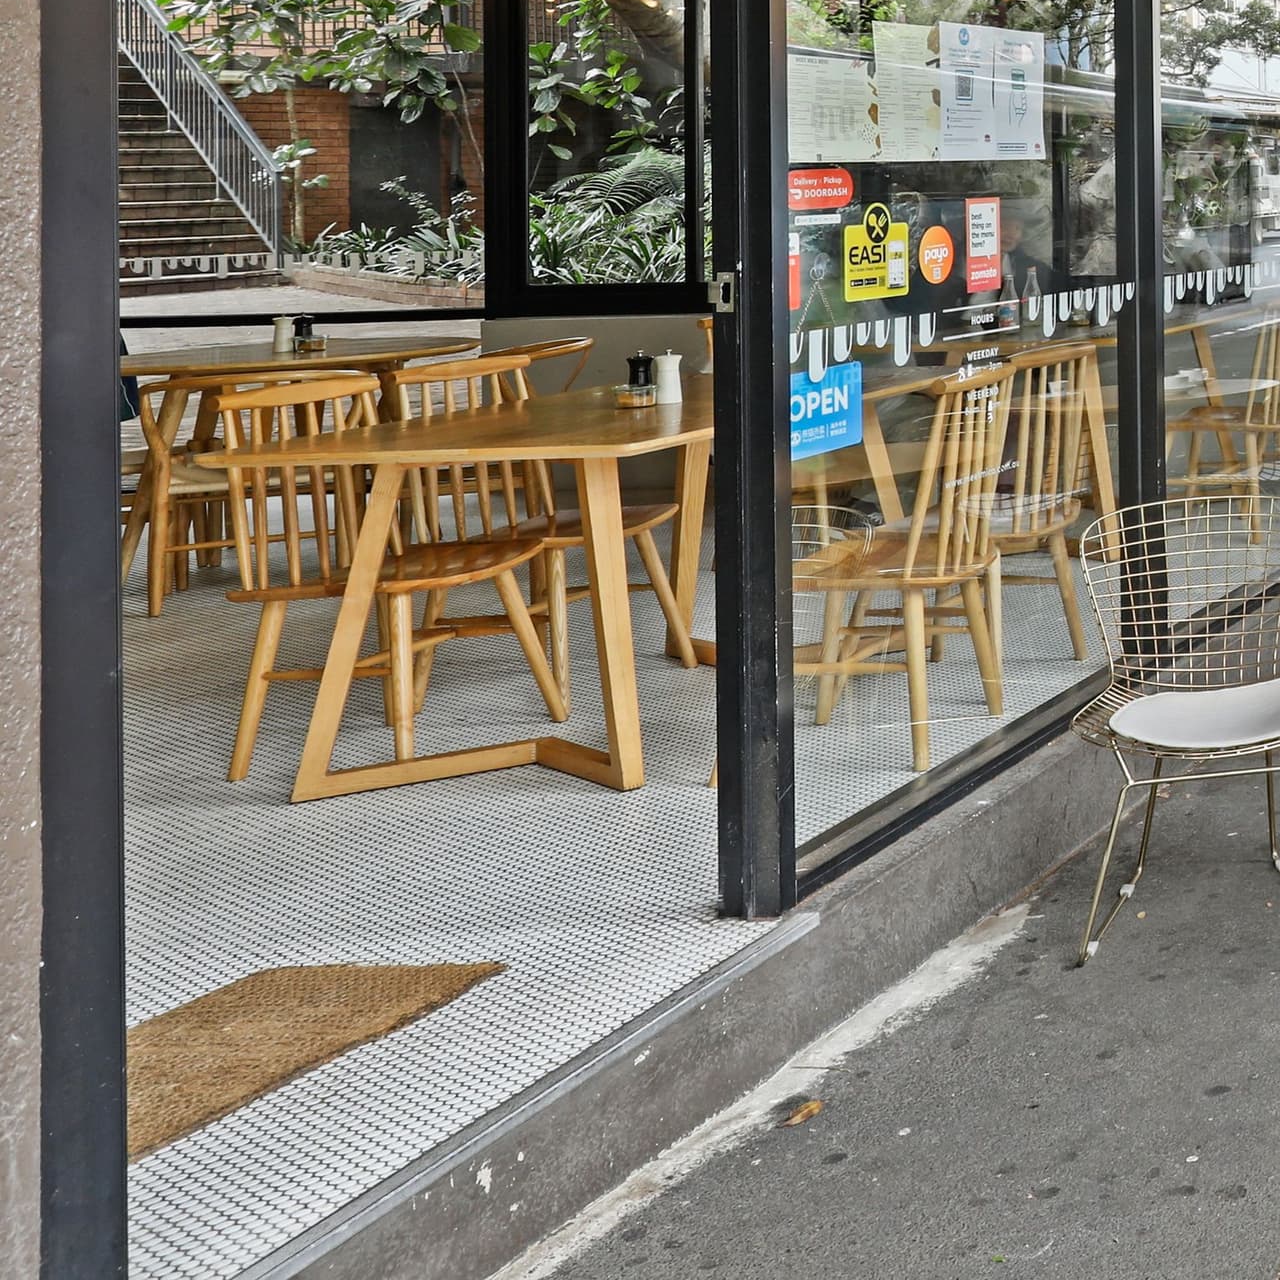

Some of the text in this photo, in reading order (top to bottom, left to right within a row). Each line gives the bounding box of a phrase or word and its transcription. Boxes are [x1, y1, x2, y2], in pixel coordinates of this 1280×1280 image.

[793, 177, 842, 186] Delivery Pickup
[804, 187, 848, 198] DOORDASH
[849, 244, 886, 265] EASI
[924, 247, 949, 264] payo
[971, 313, 994, 325] HOURS
[966, 347, 999, 362] WEEKDAY
[966, 385, 999, 401] WEEKEND
[791, 384, 849, 423] OPEN
